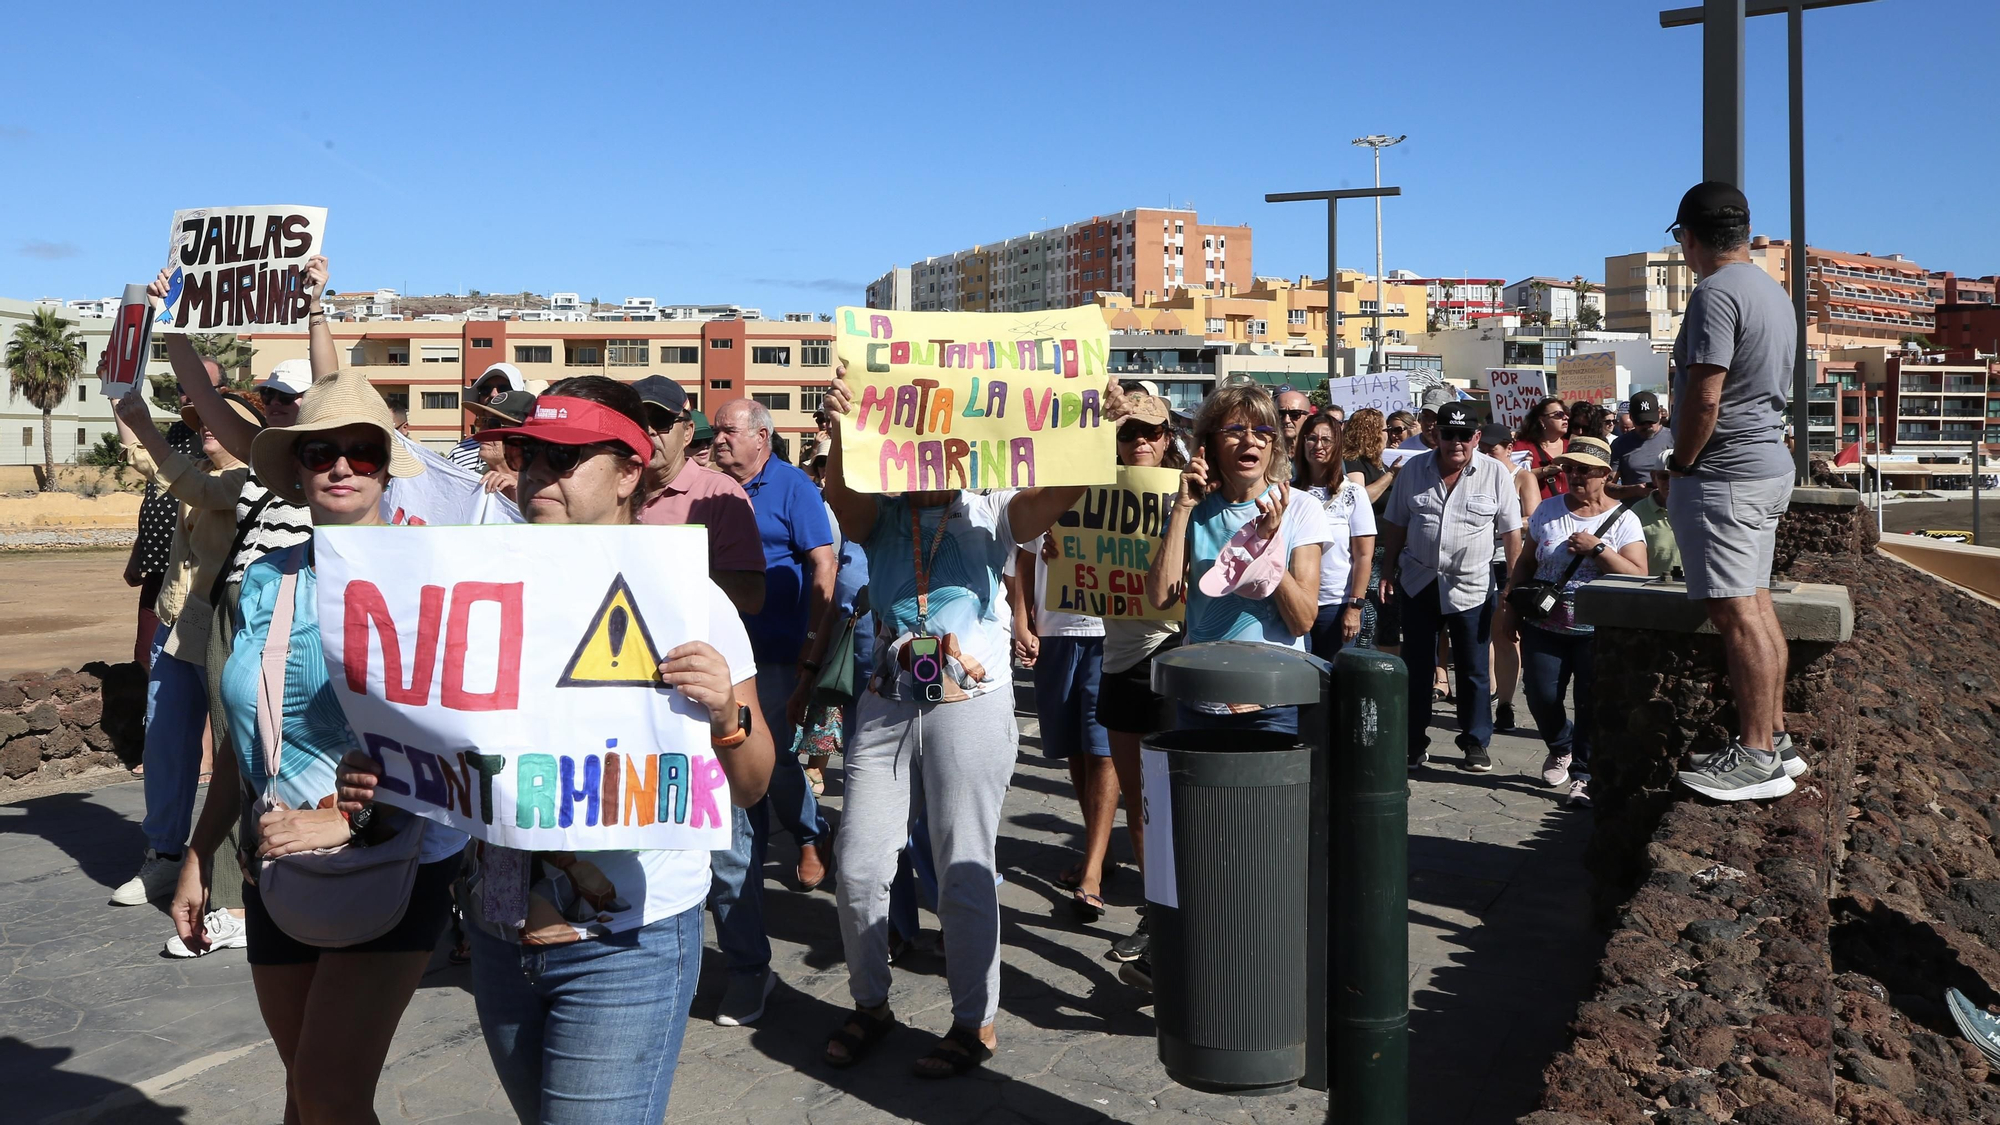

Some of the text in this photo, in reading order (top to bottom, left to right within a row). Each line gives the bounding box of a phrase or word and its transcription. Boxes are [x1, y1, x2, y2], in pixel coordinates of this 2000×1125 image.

[180, 214, 313, 266] JAULAS
[844, 309, 893, 339] LA
[1350, 375, 1401, 396] MAR
[1491, 370, 1519, 388] POR
[1517, 385, 1543, 397] UNA
[855, 378, 955, 436] MATA
[962, 376, 1008, 419] LA
[1495, 393, 1538, 411] PLAYA
[1561, 386, 1615, 402] JAULAS
[1063, 535, 1150, 571] EL MAR
[1075, 563, 1099, 590] ES
[1058, 584, 1087, 612] LA
[342, 579, 525, 712] NO
